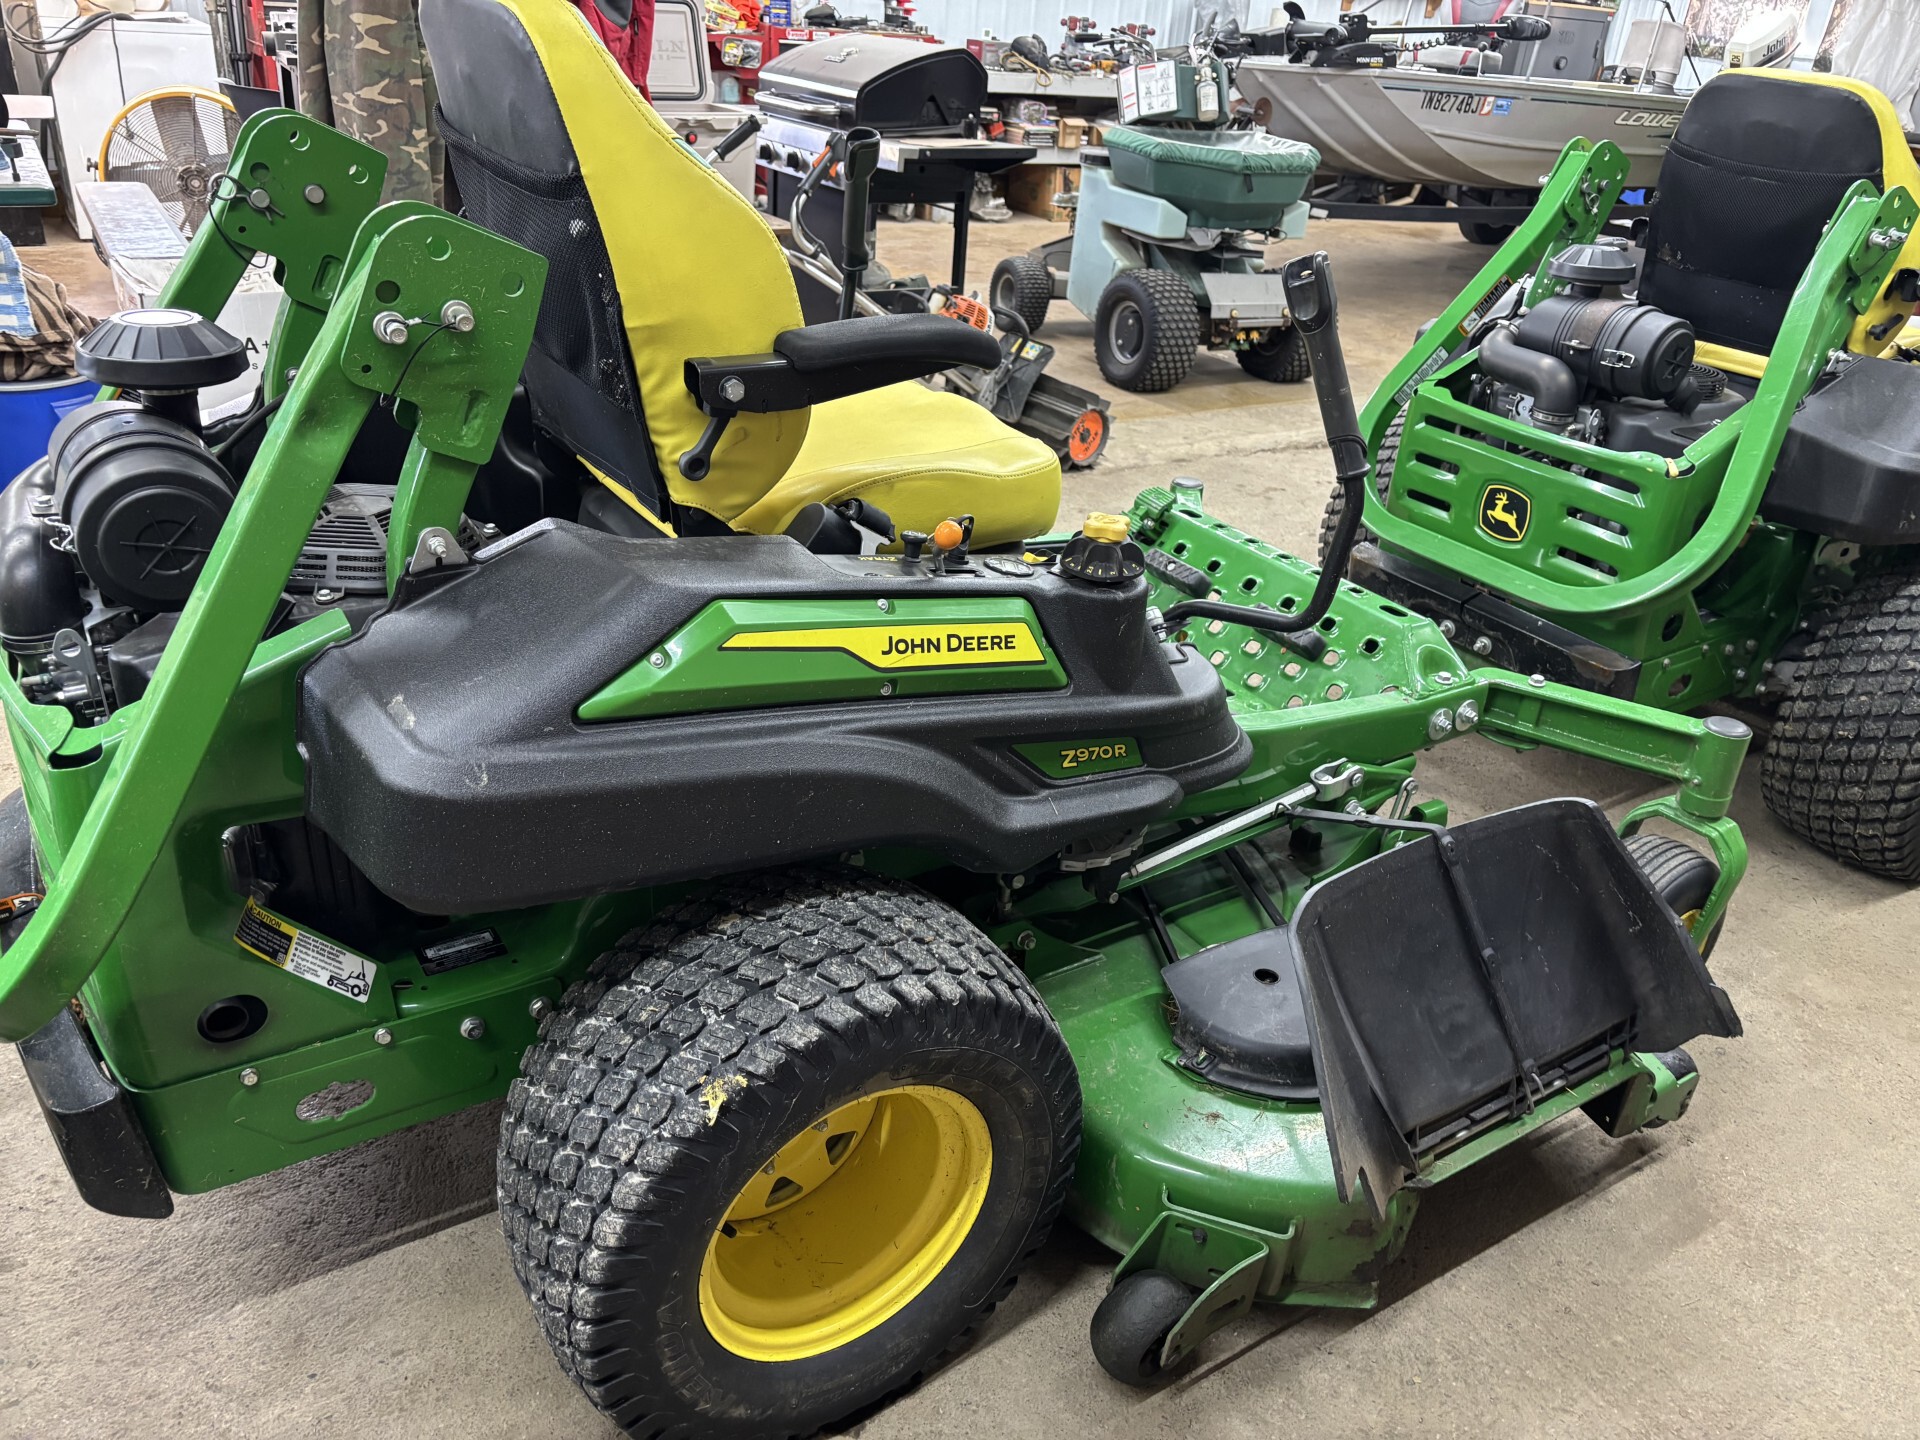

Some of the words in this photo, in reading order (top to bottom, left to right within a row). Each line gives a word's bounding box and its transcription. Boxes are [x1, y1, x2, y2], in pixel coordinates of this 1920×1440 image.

[1421, 91, 1482, 114] IN8274BJ
[1614, 110, 1684, 128] LOWE
[881, 635, 941, 656] JOHN
[946, 633, 1016, 652] DEERE
[1061, 744, 1127, 769] Z970R
[251, 908, 282, 929] CAUTION
